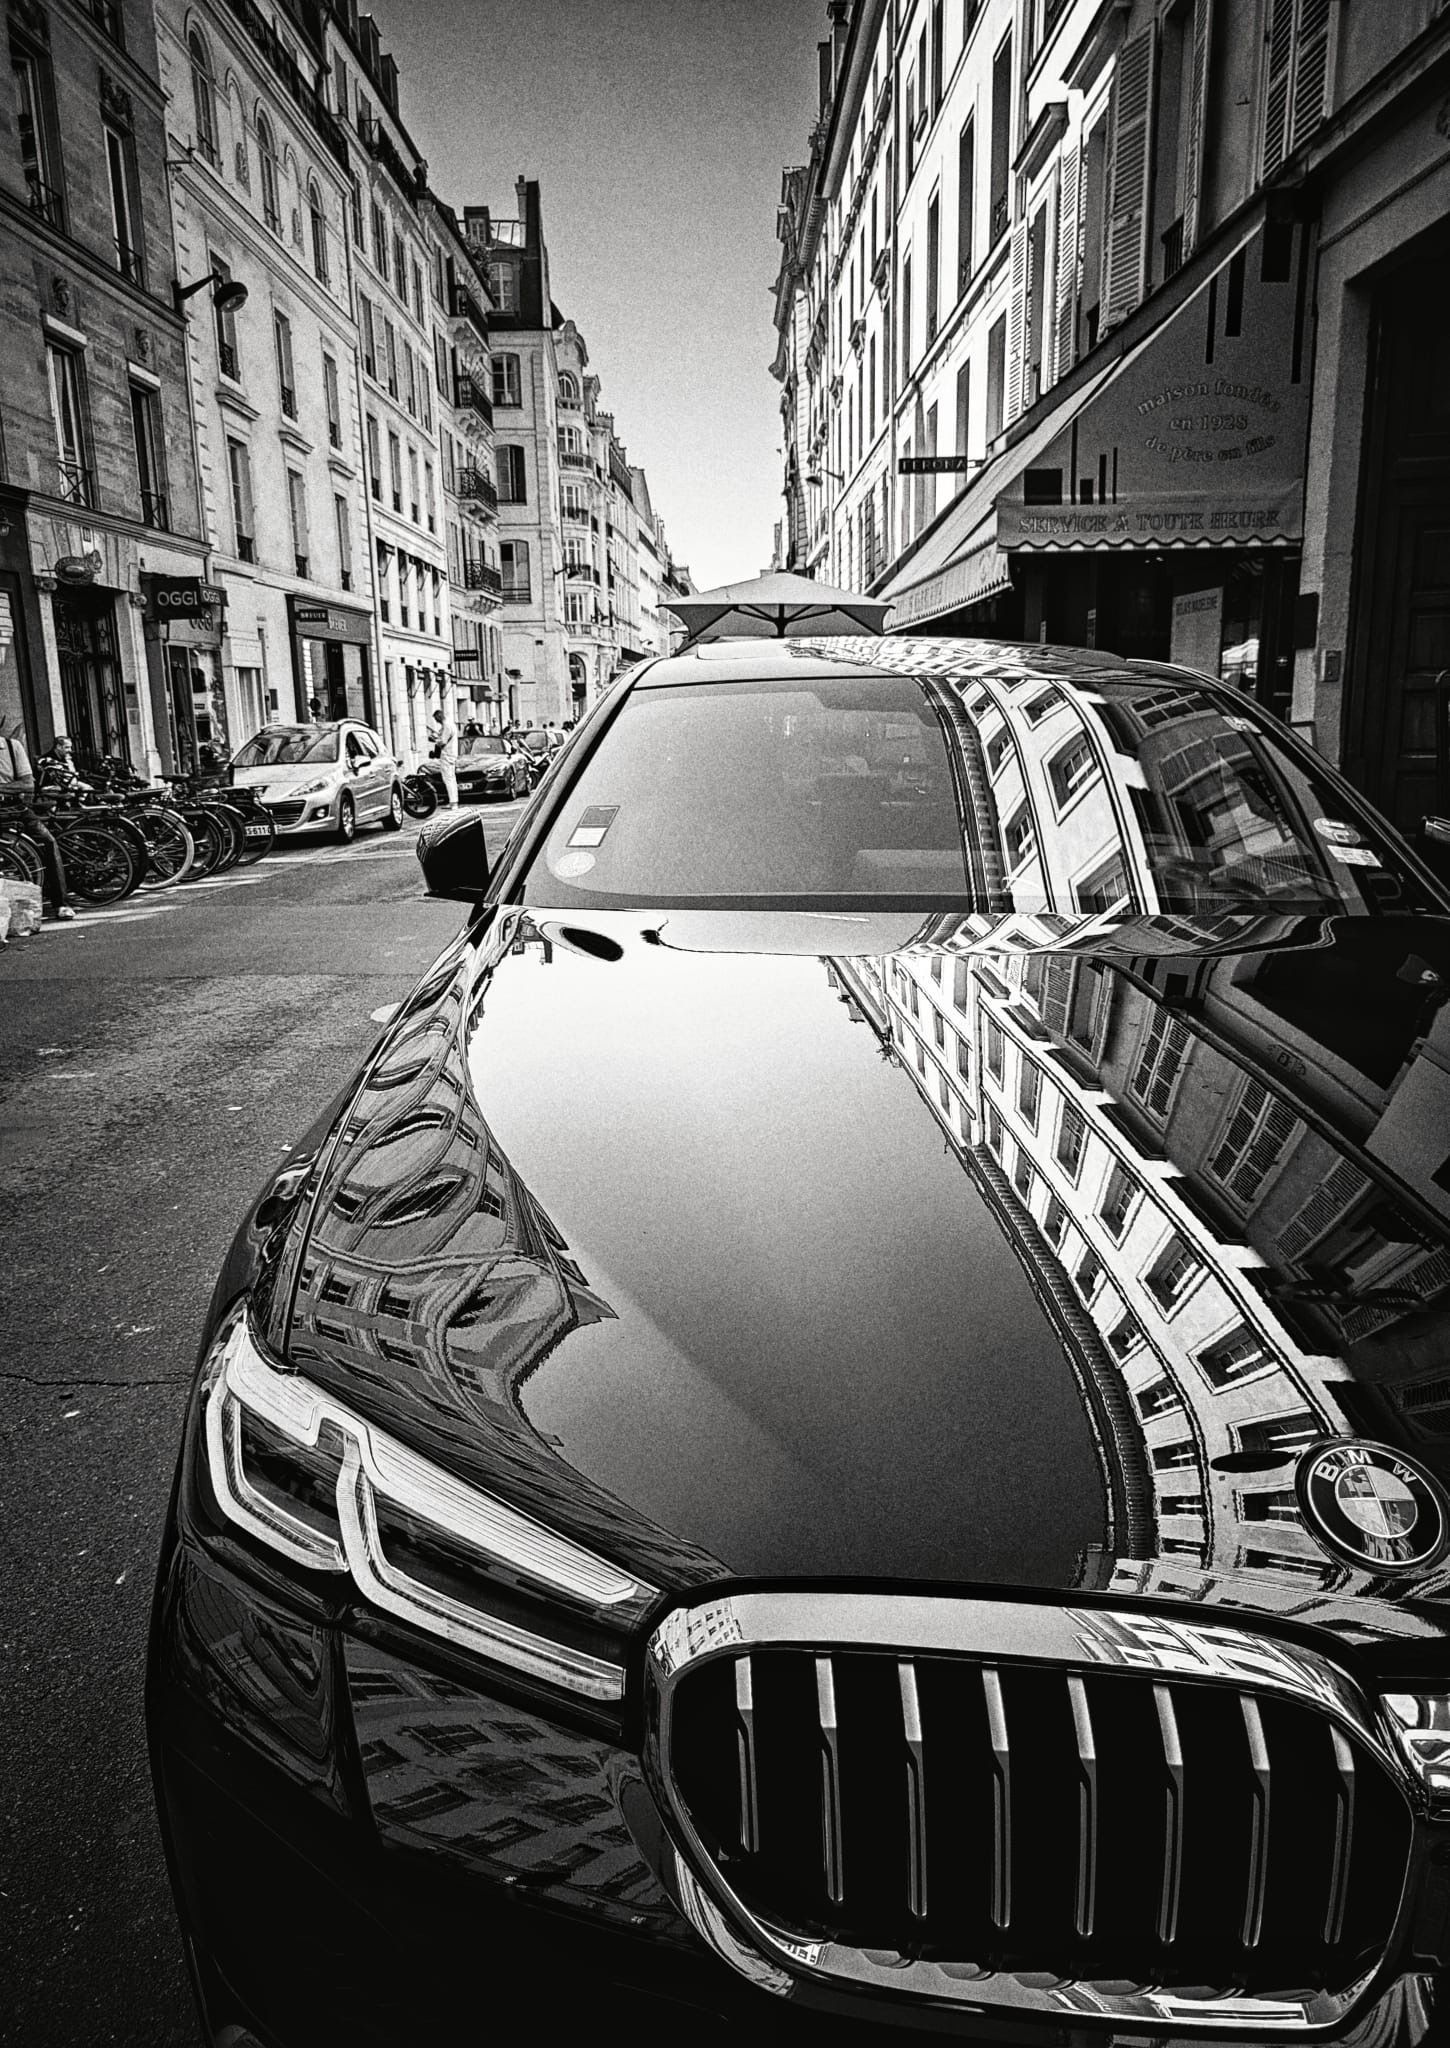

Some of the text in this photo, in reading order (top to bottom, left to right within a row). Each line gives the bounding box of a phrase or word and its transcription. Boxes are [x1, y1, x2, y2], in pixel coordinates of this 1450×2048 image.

[1137, 384, 1209, 416] maison
[1170, 417, 1192, 430] en
[1145, 436, 1167, 453] de
[1019, 514, 1107, 534] SERVICE
[1136, 513, 1204, 531] TOUTE
[1210, 510, 1280, 530] HEURE
[157, 591, 198, 606] OGGI
[1314, 1449, 1417, 1484] BMW
